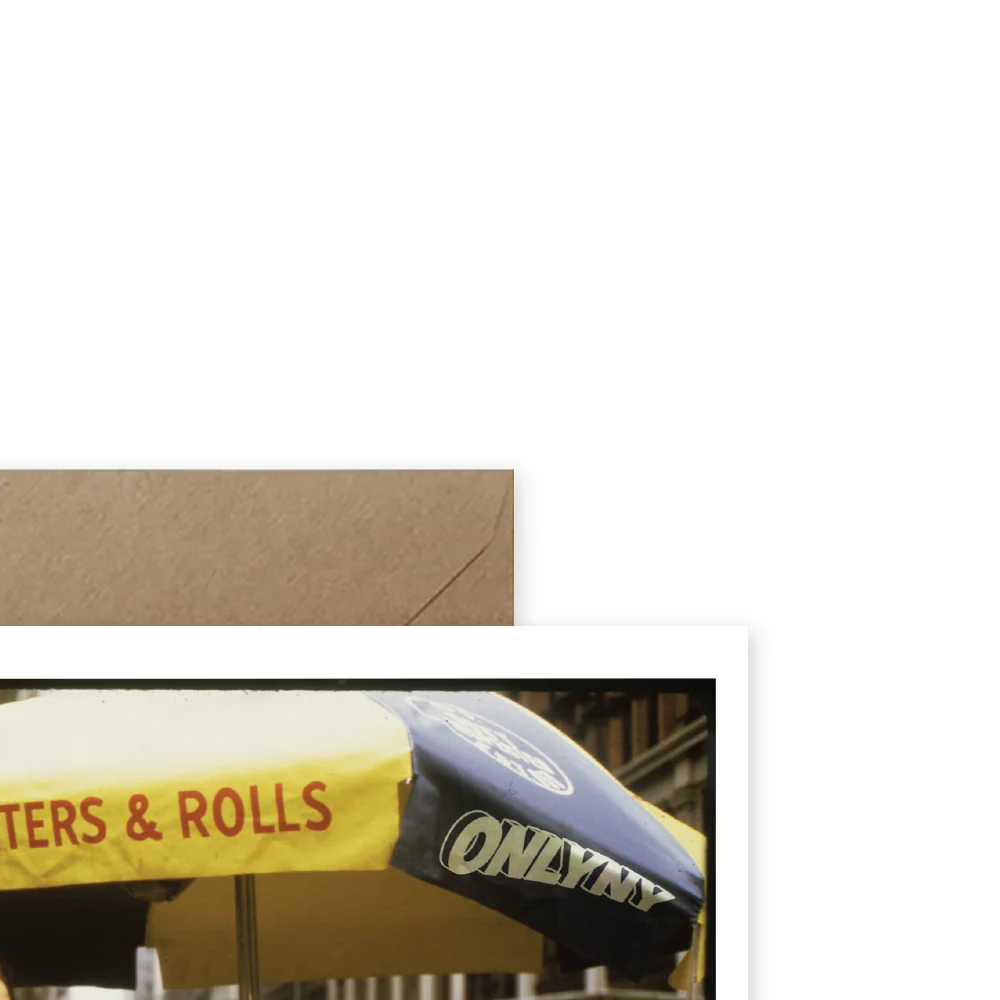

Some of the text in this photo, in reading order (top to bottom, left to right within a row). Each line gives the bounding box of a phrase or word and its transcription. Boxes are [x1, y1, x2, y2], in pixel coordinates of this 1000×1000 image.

[126, 793, 163, 841] &
[178, 781, 332, 838] ROLLS
[439, 809, 676, 912] ONLYNY
